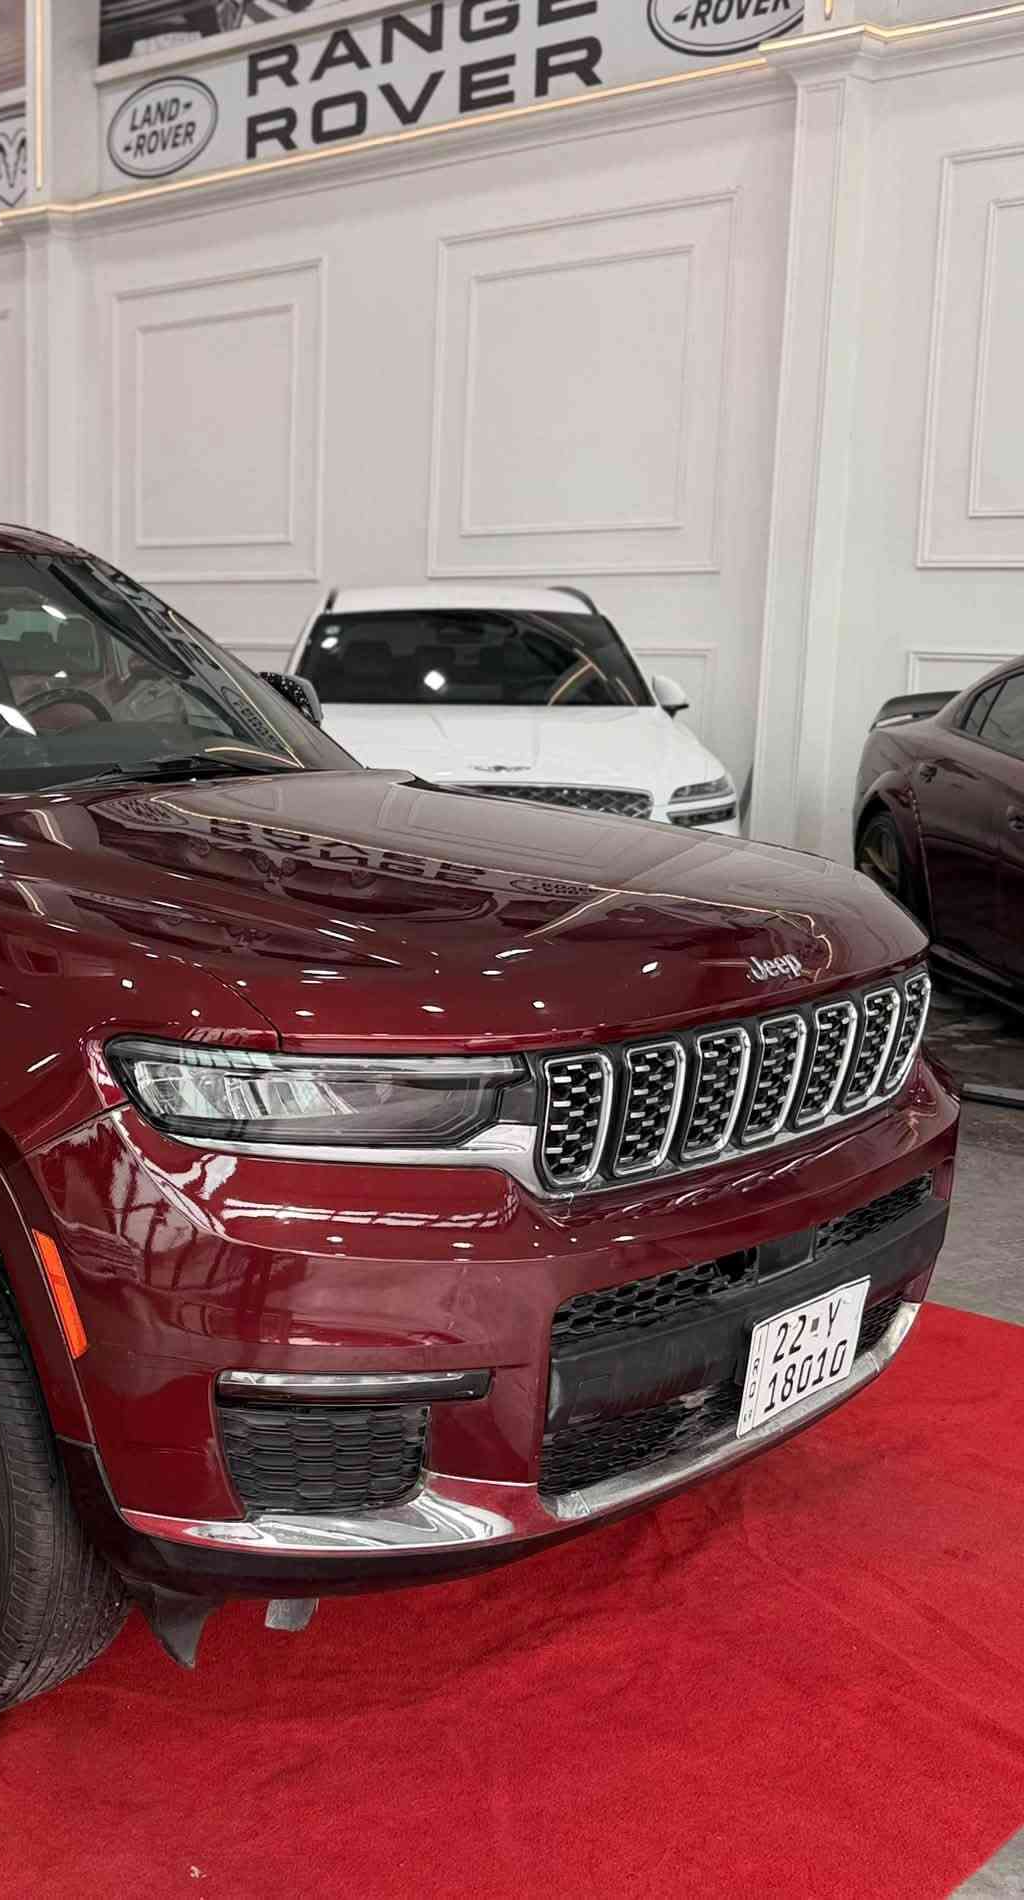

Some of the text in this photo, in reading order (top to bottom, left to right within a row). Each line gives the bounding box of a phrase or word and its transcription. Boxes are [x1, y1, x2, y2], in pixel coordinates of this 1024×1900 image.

[246, 36, 602, 160] ROVER
[750, 953, 802, 980] Jeep
[773, 1315, 807, 1363] 22
[764, 1340, 848, 1413] 18010
